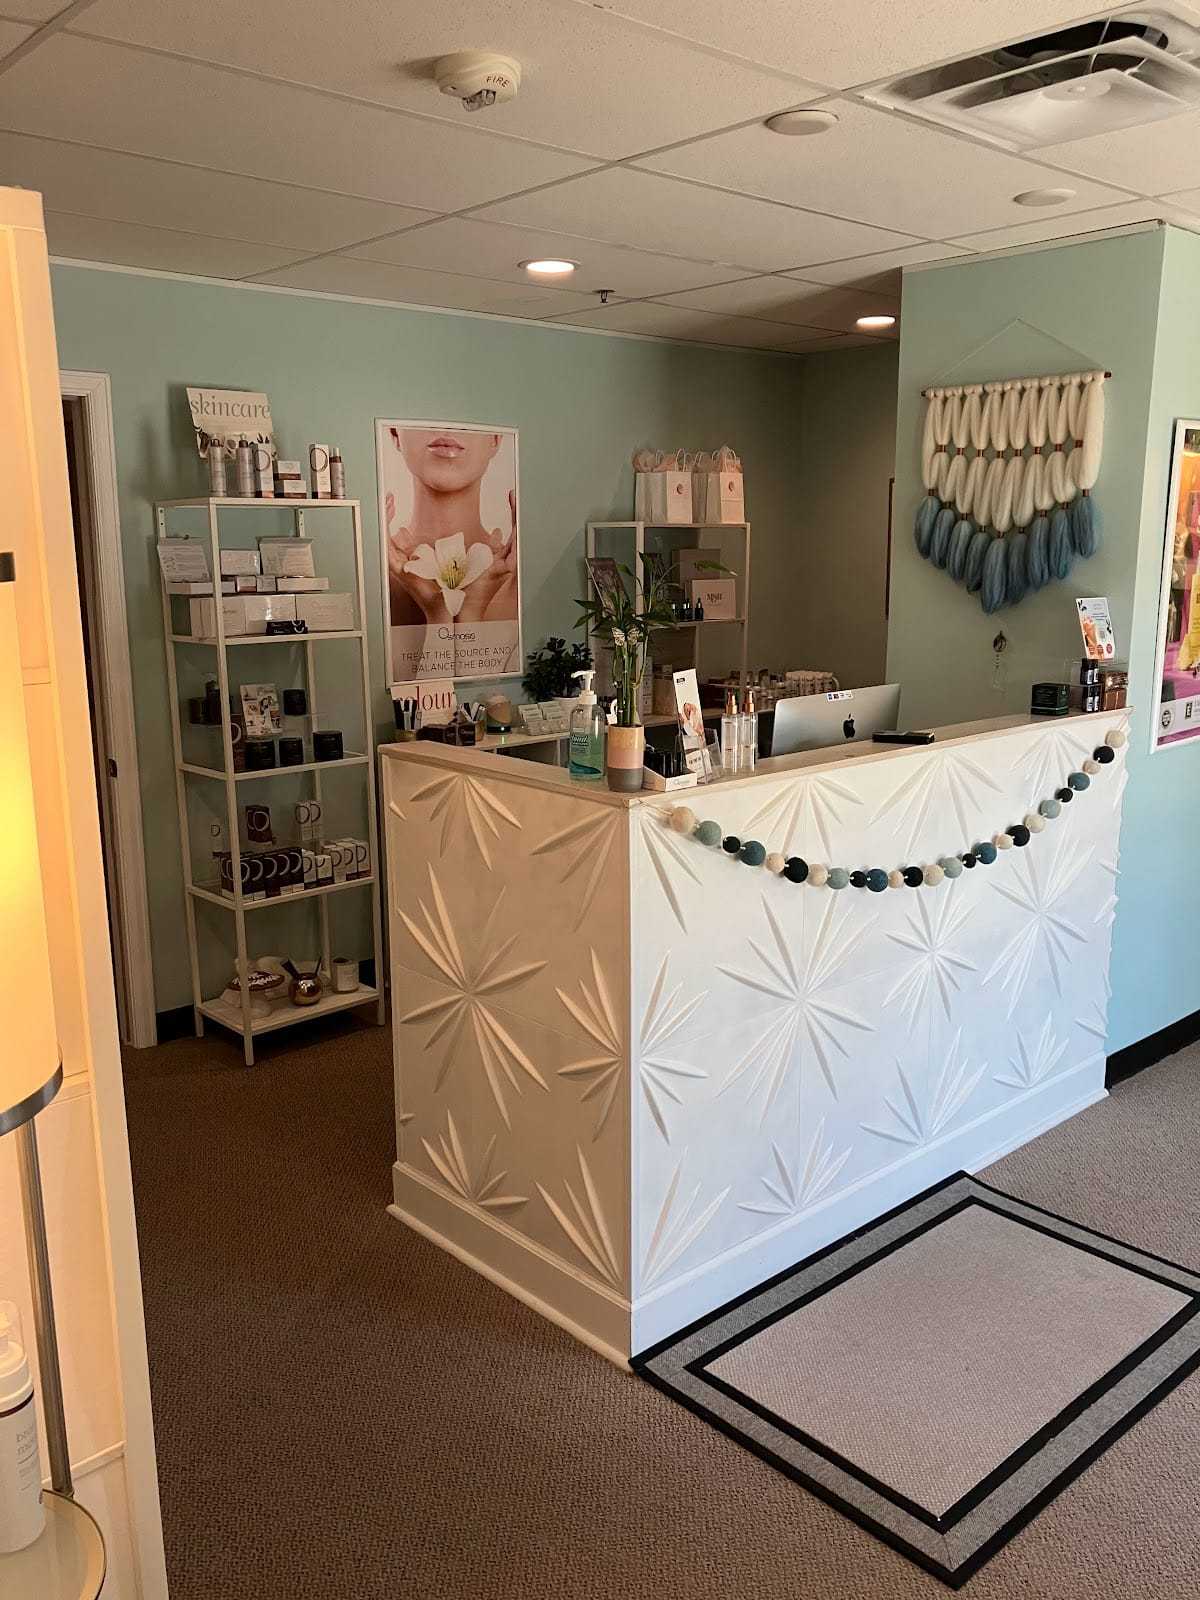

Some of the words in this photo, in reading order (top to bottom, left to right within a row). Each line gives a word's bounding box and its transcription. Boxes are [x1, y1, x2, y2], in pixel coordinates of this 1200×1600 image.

[486, 75, 510, 87] FIRE
[191, 393, 271, 418] skincare
[402, 651, 431, 662] TREAT
[435, 650, 452, 660] THE
[454, 647, 490, 658] SOURCE
[492, 646, 511, 656] AND
[411, 661, 455, 673] BALANCE
[457, 660, 476, 670] THE
[478, 658, 502, 669] BODY
[395, 686, 454, 711] lour
